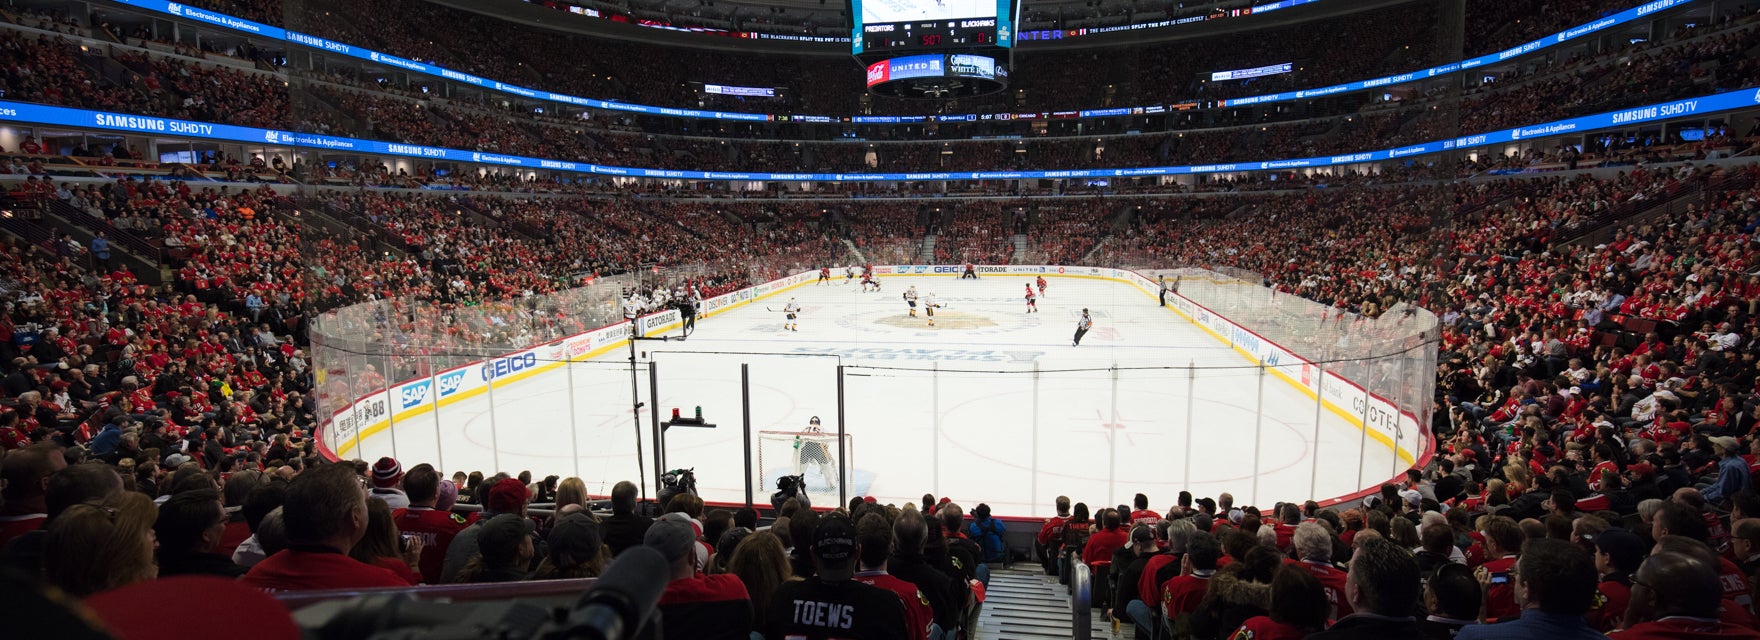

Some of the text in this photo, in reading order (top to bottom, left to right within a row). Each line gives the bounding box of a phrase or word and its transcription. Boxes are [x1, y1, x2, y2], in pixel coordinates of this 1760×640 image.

[1265, 3, 1280, 11] LIGHT
[1637, 0, 1674, 16] SAMSUNG
[185, 8, 221, 23] Electronics
[227, 20, 260, 30] Appliances
[961, 20, 995, 28] BLACKHAWKS
[1100, 25, 1131, 33] BLACKHAWKS
[1176, 15, 1204, 24] CURRENTLY
[1567, 28, 1587, 37] Electronics
[1592, 19, 1615, 29] Appliances
[287, 33, 323, 46] SAMSUNG
[977, 32, 985, 43] 0
[1500, 47, 1522, 58] SAMSUNG
[892, 64, 928, 73] UNITED
[951, 65, 975, 73] WHITE
[1364, 78, 1391, 86] SAMSUNG
[96, 114, 165, 129] SAMSUNG
[1613, 108, 1657, 122] SAMSUNG
[1522, 128, 1545, 136] Electronics
[1550, 124, 1576, 132] Appliances
[282, 135, 316, 143] Electronics
[388, 144, 422, 154] SAMSUNG
[646, 312, 676, 328] GATORADE
[482, 352, 536, 382] GEICO
[441, 374, 461, 390] SAP
[402, 384, 427, 404] SAP
[372, 400, 385, 418] 88
[1353, 396, 1392, 431] COOTE
[793, 599, 854, 630] TOEWS
